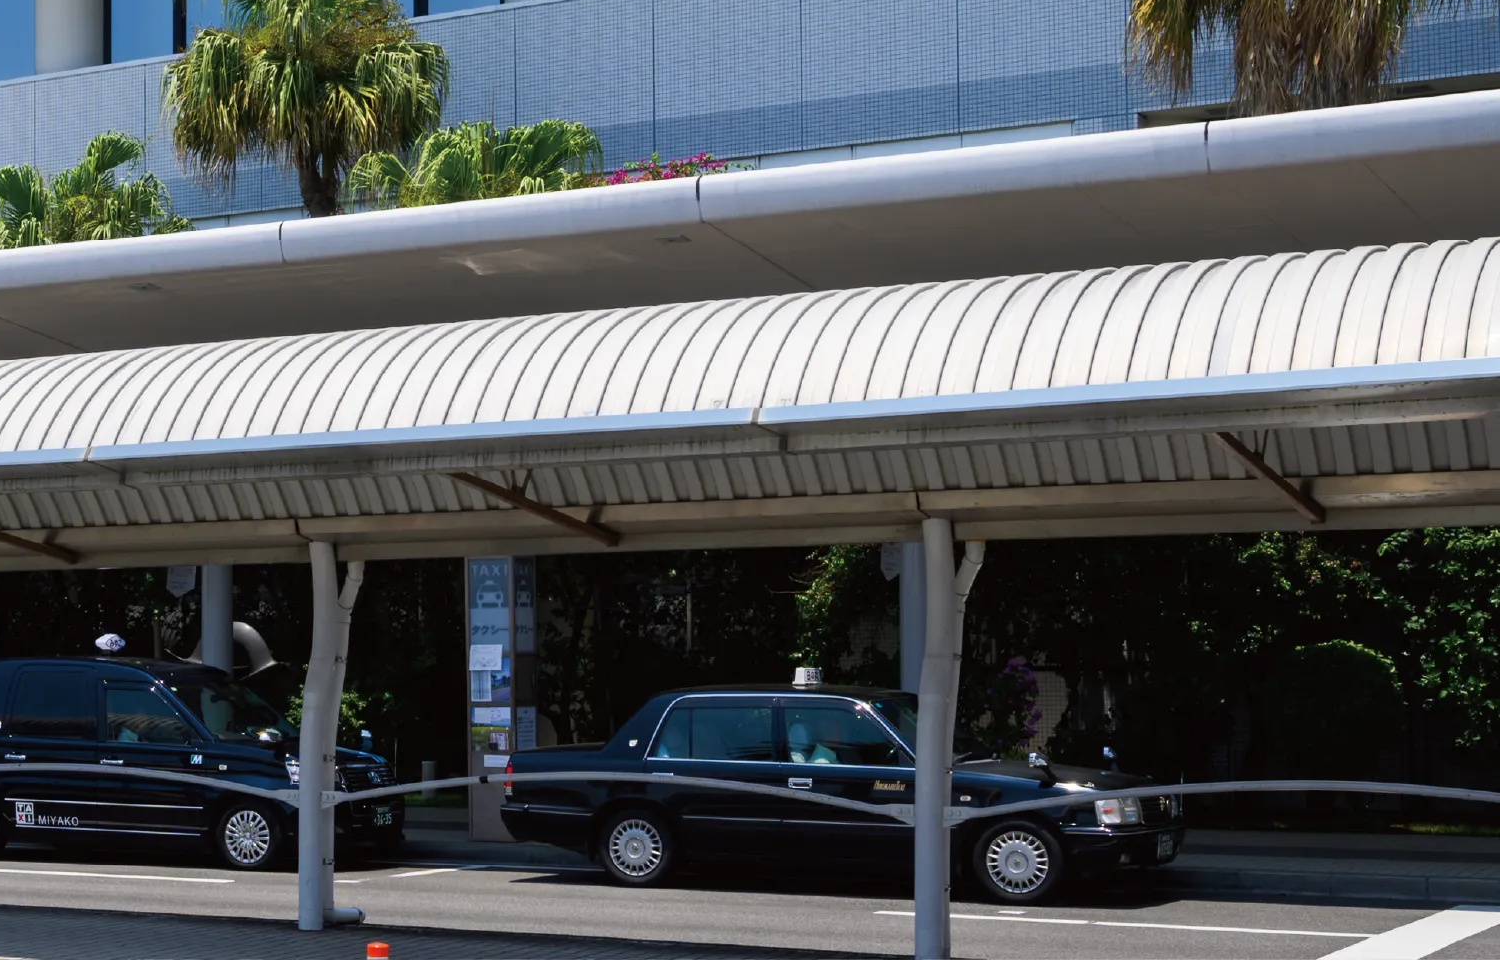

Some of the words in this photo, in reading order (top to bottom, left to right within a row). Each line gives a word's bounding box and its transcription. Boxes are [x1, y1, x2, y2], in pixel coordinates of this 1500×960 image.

[471, 563, 508, 578] TAXI
[471, 624, 509, 636] タクシー
[38, 815, 79, 826] MIYAKO
